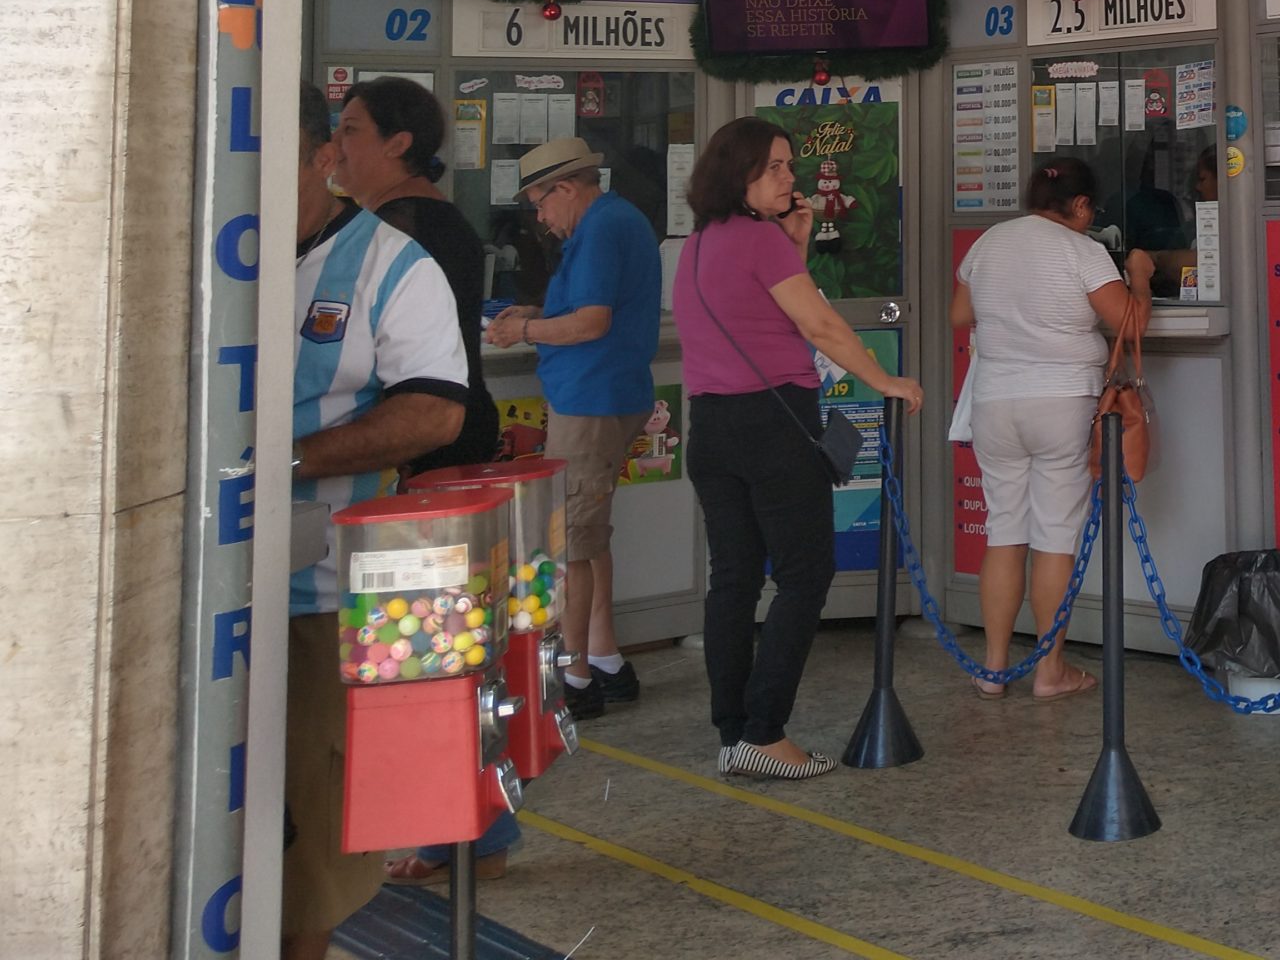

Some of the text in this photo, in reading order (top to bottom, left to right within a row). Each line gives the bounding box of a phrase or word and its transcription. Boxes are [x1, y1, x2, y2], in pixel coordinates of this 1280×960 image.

[385, 8, 431, 41] 02
[747, 6, 869, 23] ESSA HISTÓRIA
[985, 5, 1014, 37] 03
[506, 8, 665, 48] 6 MILHÕES
[747, 23, 836, 38] SE REPETIR
[775, 86, 884, 107] CAIXA
[817, 121, 847, 138] Feliz
[800, 133, 854, 158] Natal
